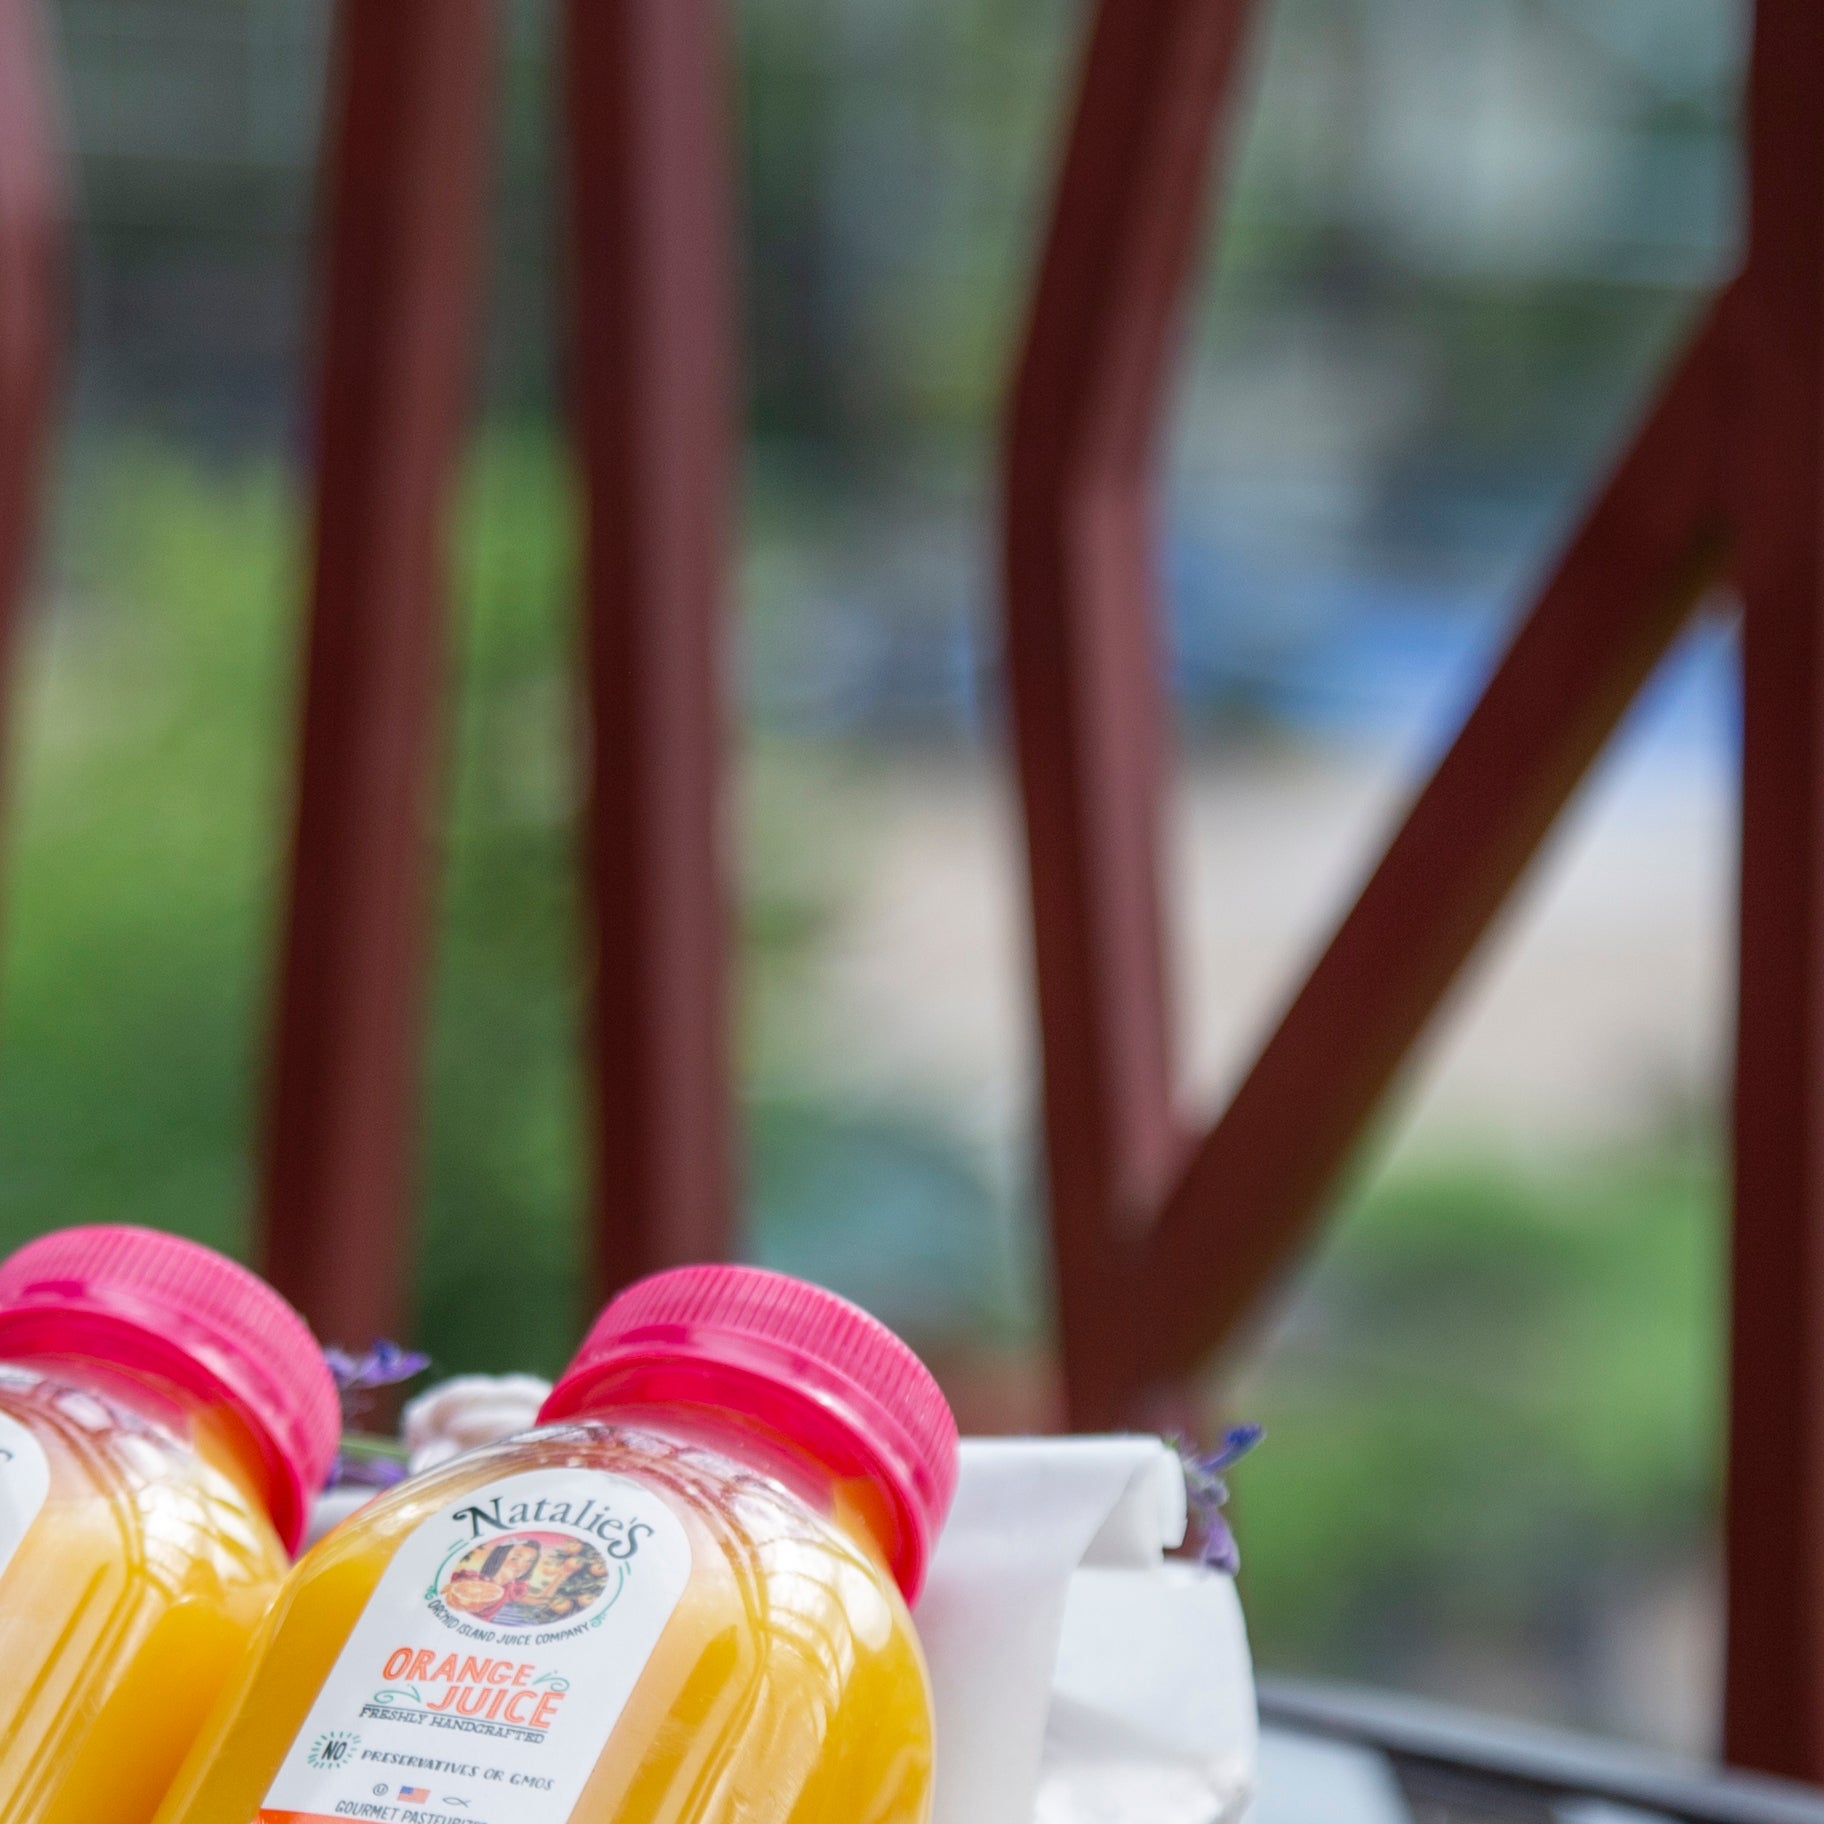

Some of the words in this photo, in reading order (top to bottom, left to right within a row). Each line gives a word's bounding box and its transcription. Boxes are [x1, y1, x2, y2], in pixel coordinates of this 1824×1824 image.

[427, 1598, 459, 1630] ORCHID
[456, 1621, 496, 1643] ISLAND
[496, 1632, 532, 1646] JUICE
[535, 1621, 591, 1645] COMPANY
[382, 1646, 536, 1687] ORANGE
[358, 1705, 429, 1726] FRESHLY
[428, 1715, 546, 1745] HANDCRAFTED
[426, 1684, 566, 1729] JUICE
[321, 1739, 348, 1761] NO
[361, 1748, 481, 1777] PRESERVATIVES
[483, 1767, 506, 1782] OR
[335, 1799, 401, 1822] GOURMET
